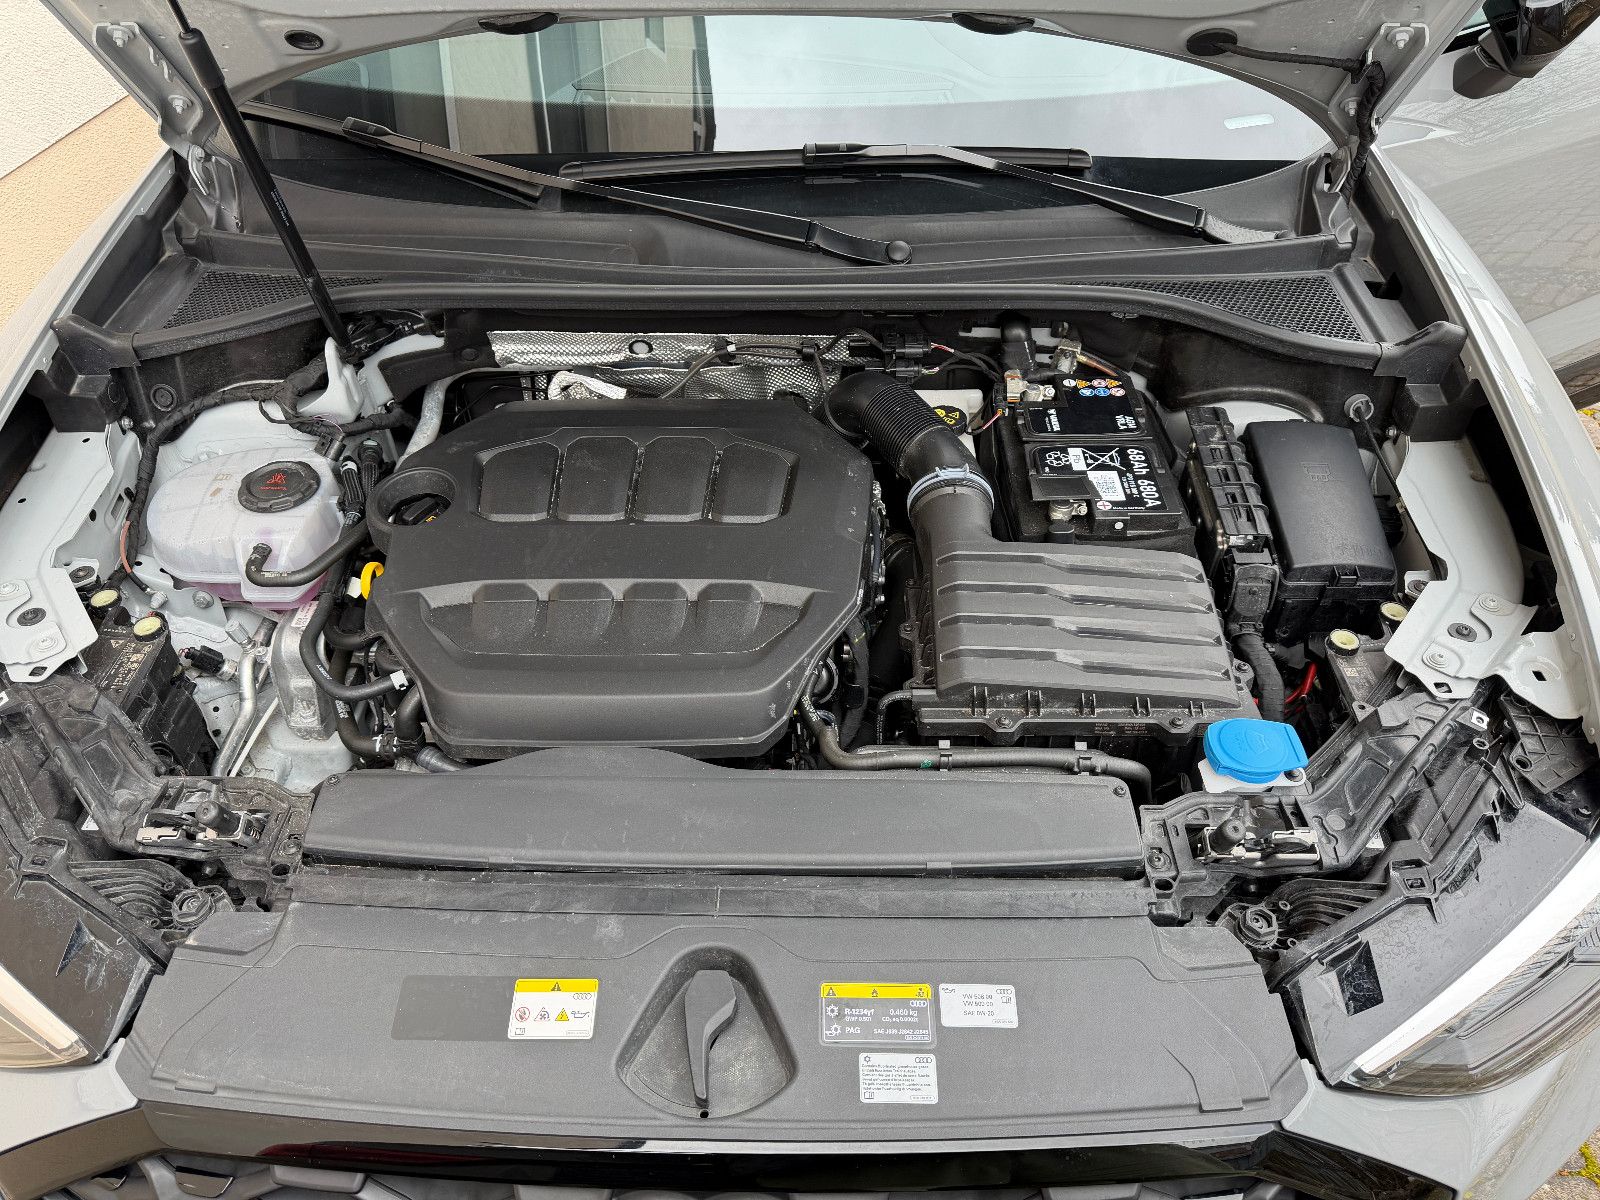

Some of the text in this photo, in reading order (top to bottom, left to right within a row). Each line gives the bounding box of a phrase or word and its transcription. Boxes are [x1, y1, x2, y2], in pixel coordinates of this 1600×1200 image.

[1127, 449, 1149, 475] 68Ah
[1137, 479, 1161, 507] 680A
[909, 1008, 918, 1016] kg
